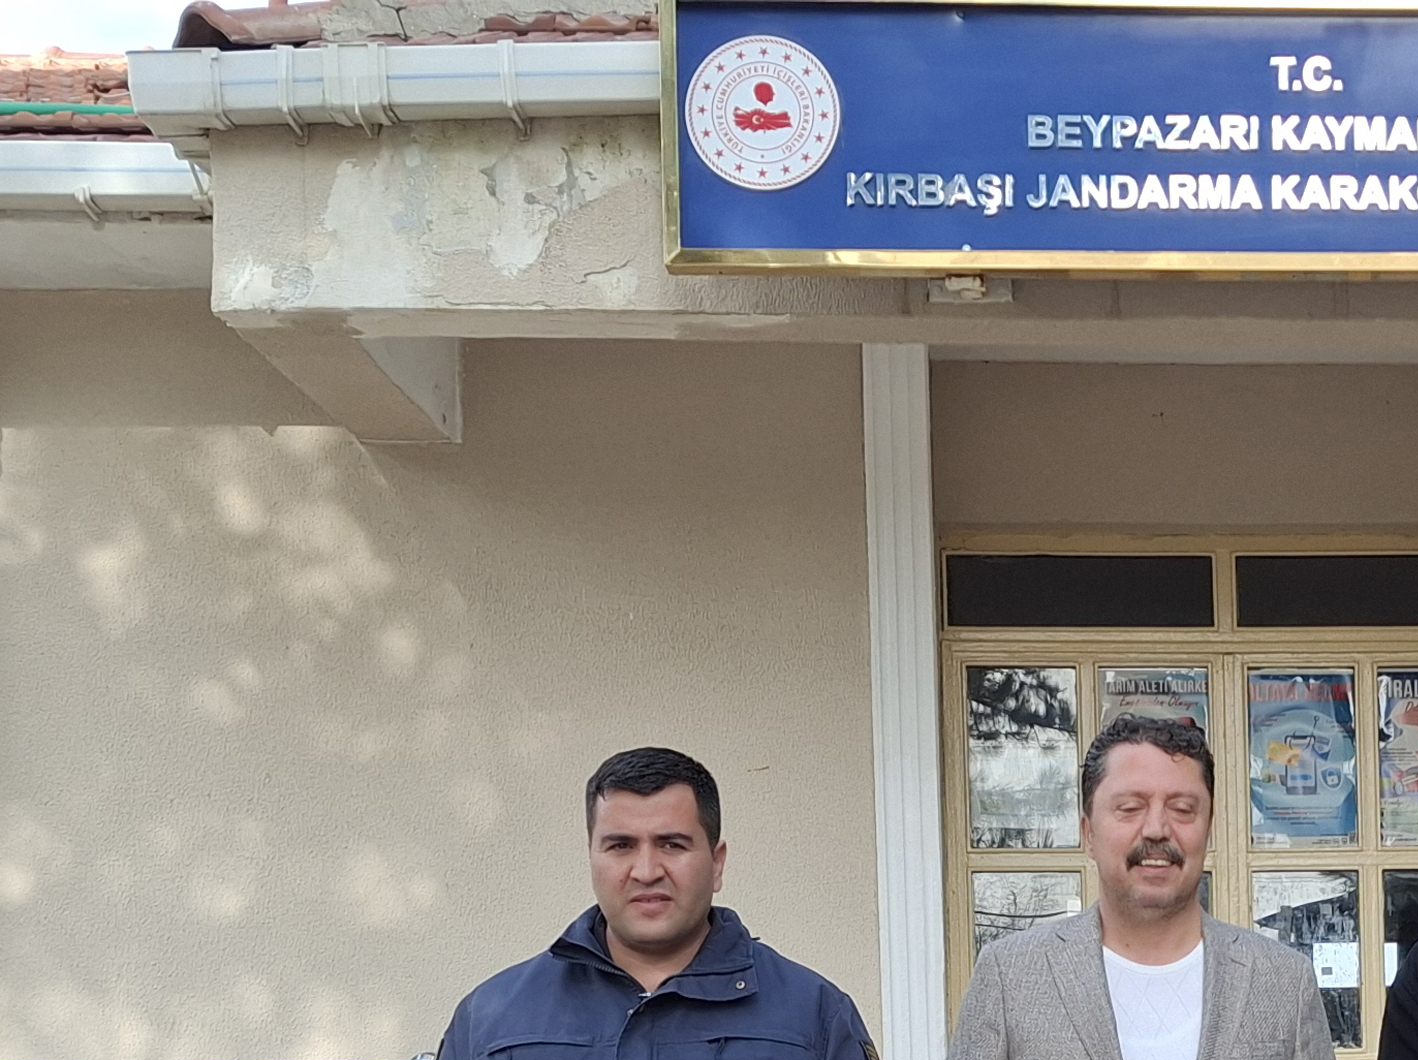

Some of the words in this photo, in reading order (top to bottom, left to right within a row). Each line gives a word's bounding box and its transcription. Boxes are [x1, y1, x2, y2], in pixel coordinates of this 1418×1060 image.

[715, 64, 770, 110] CUMHURİYETİ
[773, 65, 805, 101] İÇİŞLERİ
[1270, 55, 1343, 92] T.C.
[716, 114, 744, 154] TÜRKİYE
[782, 104, 811, 155] BAKANLIĞI
[1027, 114, 1259, 150] BEYPAZARI
[845, 171, 1014, 217] KIRBAŞI
[1025, 174, 1263, 210] JANDARMA
